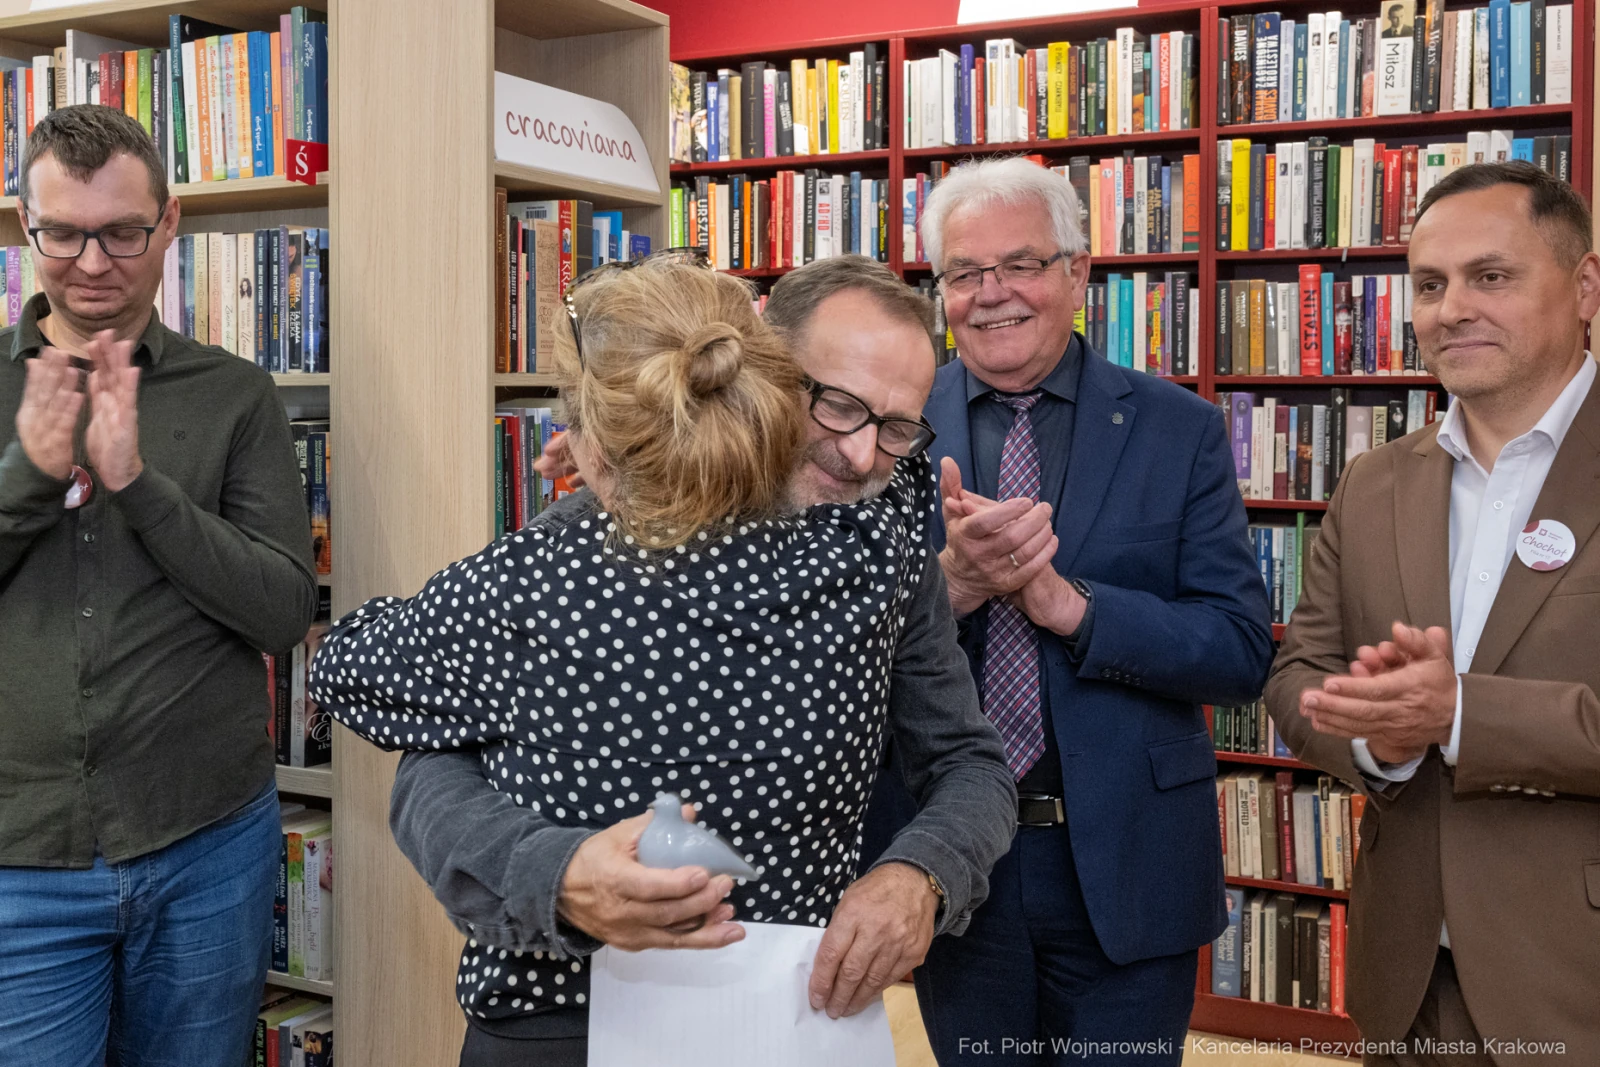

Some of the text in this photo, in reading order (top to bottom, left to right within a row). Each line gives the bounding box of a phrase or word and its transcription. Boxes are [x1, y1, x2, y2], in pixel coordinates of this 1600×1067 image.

[237, 40, 246, 69] Monika
[1132, 51, 1144, 74] BESTIA
[1234, 29, 1247, 62] DAVIES
[1427, 29, 1441, 65] WOŁYŃ
[1160, 38, 1169, 89] NOSOWSKA
[1255, 35, 1268, 121] NORMAN ZAGINIONE
[1384, 43, 1400, 89] Miłosz
[56, 66, 67, 104] ANDRZEJ
[839, 82, 850, 121] QUEEN
[1263, 88, 1278, 121] DAVIES
[506, 110, 637, 163] cracoviana
[295, 145, 309, 176] Ś
[1185, 181, 1199, 229] GUCCI
[1217, 184, 1231, 205] 1945
[697, 198, 708, 248] URSZUL
[1175, 277, 1186, 300] Miss
[1175, 301, 1186, 324] Dior
[1303, 289, 1318, 351] STALIN
[1375, 413, 1384, 447] KUBIA
[1240, 800, 1250, 826] ROTFELD
[1217, 934, 1227, 961] atcher
[1225, 924, 1238, 962] Margaret
